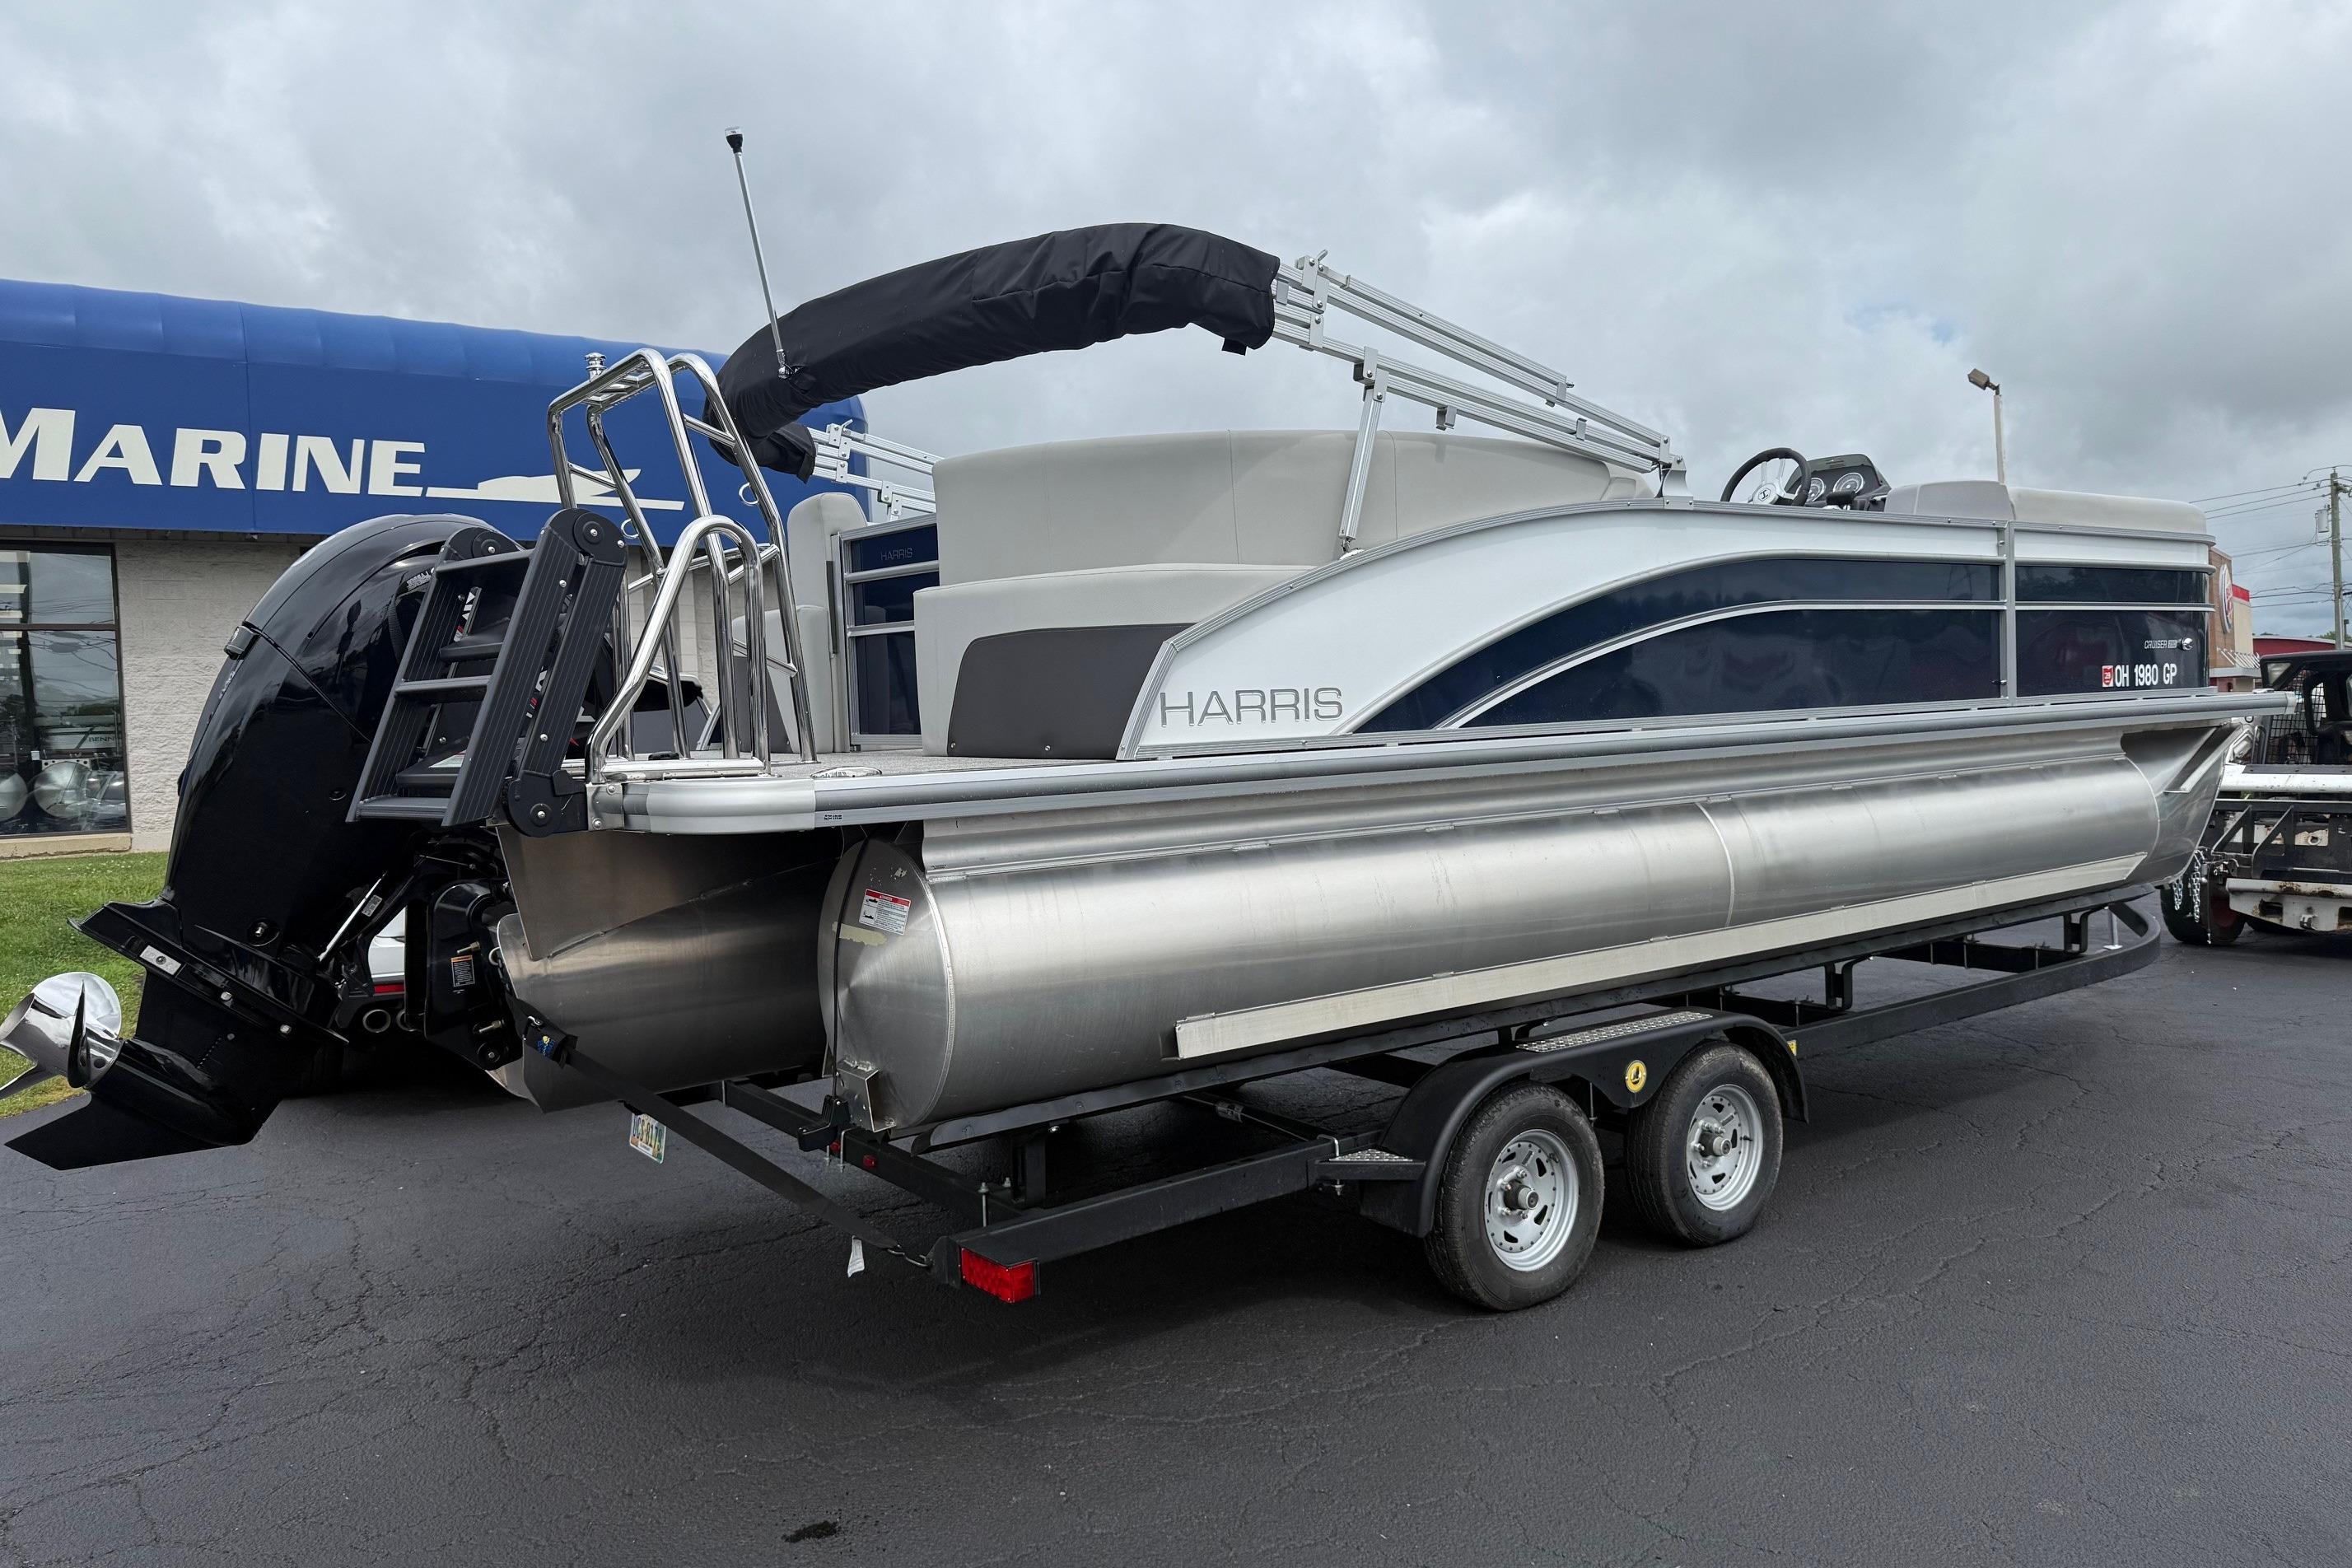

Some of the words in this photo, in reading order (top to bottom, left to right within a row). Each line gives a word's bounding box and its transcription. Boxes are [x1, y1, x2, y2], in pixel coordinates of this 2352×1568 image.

[0, 407, 426, 497] MARINE
[880, 548, 913, 561] HARRIS
[2144, 640, 2168, 649] CRUISER
[2115, 665, 2130, 688] OH
[2134, 663, 2158, 687] 1980
[2163, 662, 2177, 685] GP
[1160, 687, 1343, 728] HARRIS
